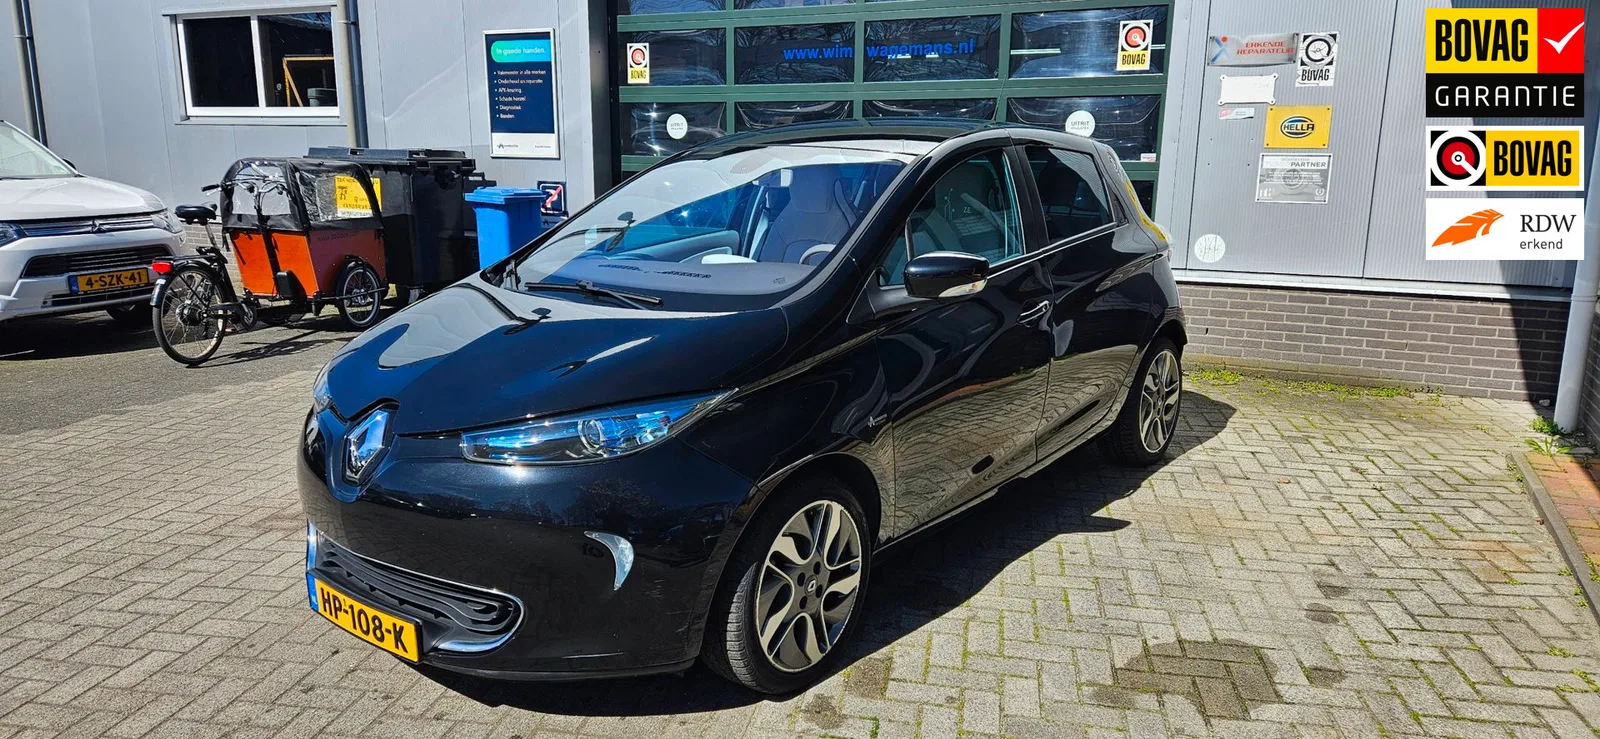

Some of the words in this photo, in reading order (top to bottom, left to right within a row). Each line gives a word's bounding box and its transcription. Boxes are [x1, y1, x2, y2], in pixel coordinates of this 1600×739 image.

[523, 46, 545, 54] handen
[782, 44, 853, 60] www.wim
[867, 38, 975, 60] wagemans.nl
[1236, 47, 1294, 55] REPARATEUR
[1122, 53, 1146, 65] BOVAG
[630, 69, 647, 79] BOVAG
[1283, 123, 1315, 131] HELLA
[85, 271, 143, 288] 4-SZK-41
[320, 587, 409, 654] HP-108-K
